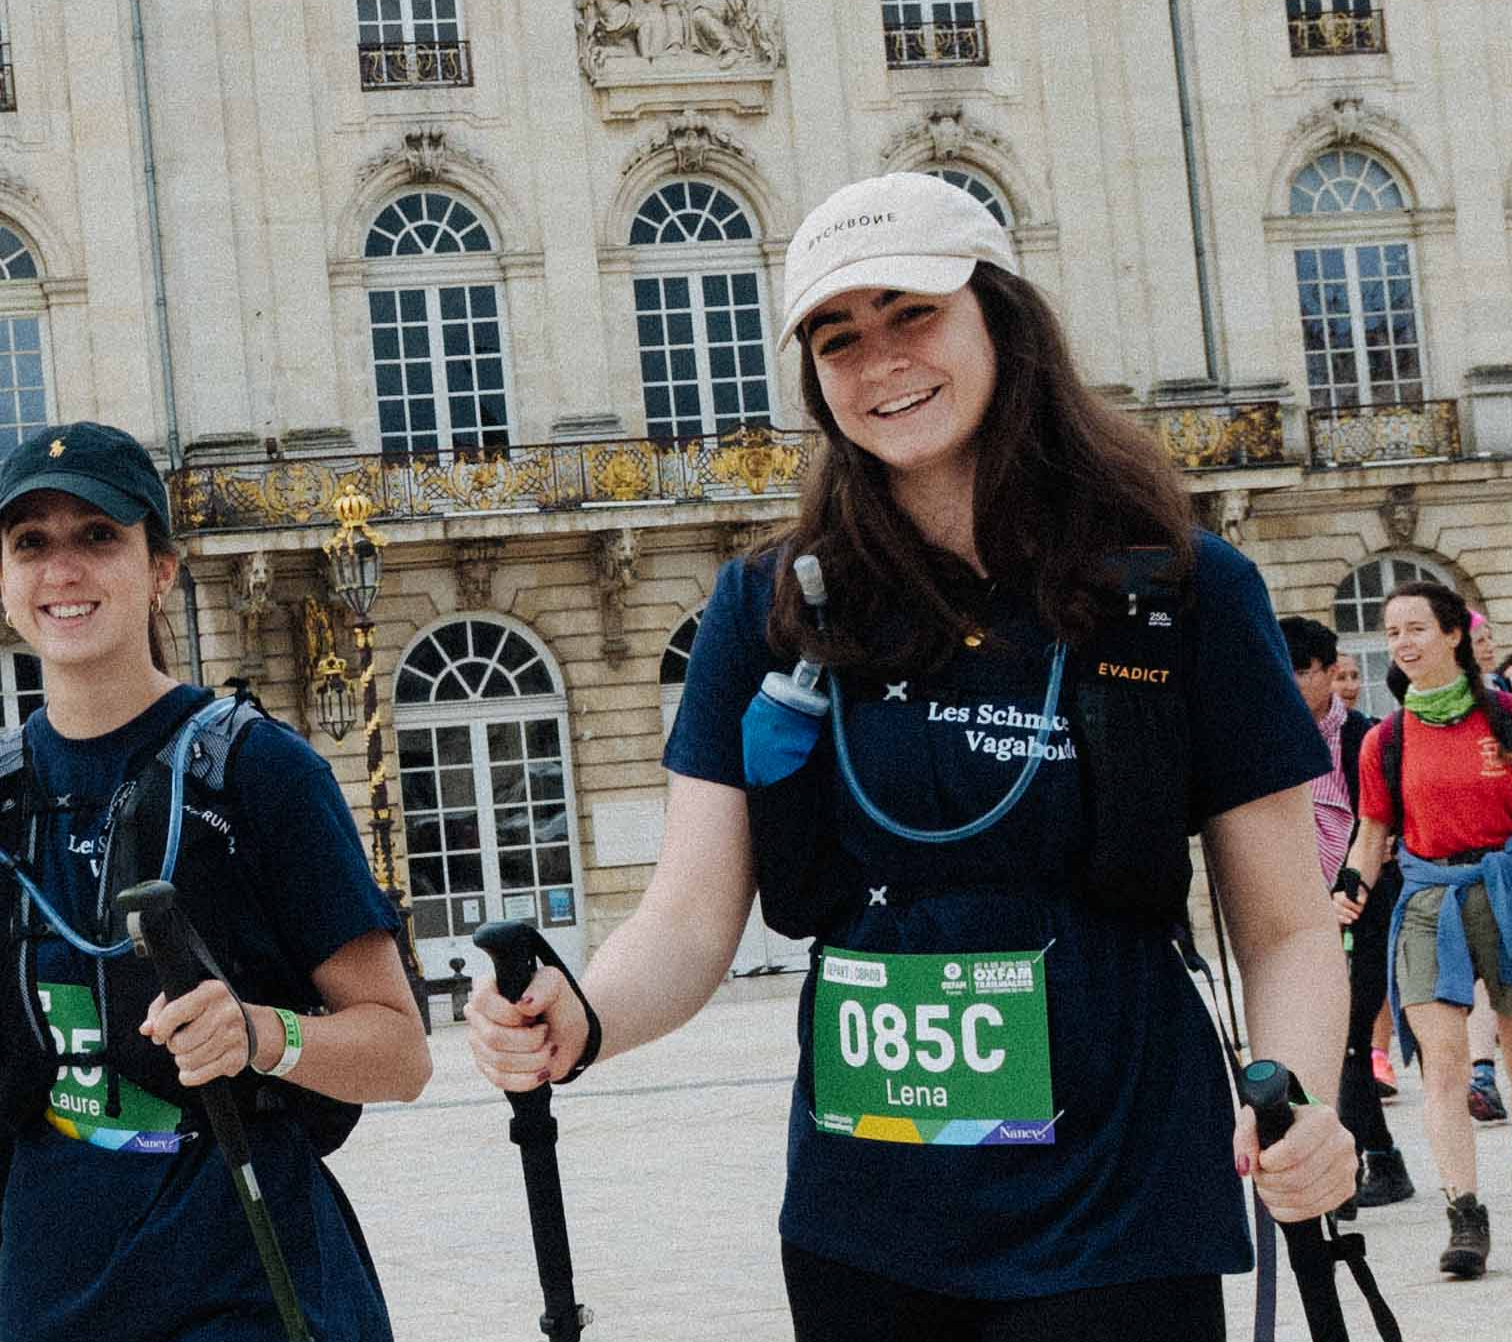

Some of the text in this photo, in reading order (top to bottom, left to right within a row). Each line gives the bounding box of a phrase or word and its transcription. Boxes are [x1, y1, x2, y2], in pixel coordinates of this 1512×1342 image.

[1098, 662, 1170, 684] EVADICT
[927, 702, 971, 723] Les
[974, 968, 1033, 980] OXFAM
[839, 1000, 1006, 1073] 085C
[886, 1078, 948, 1107] Lena
